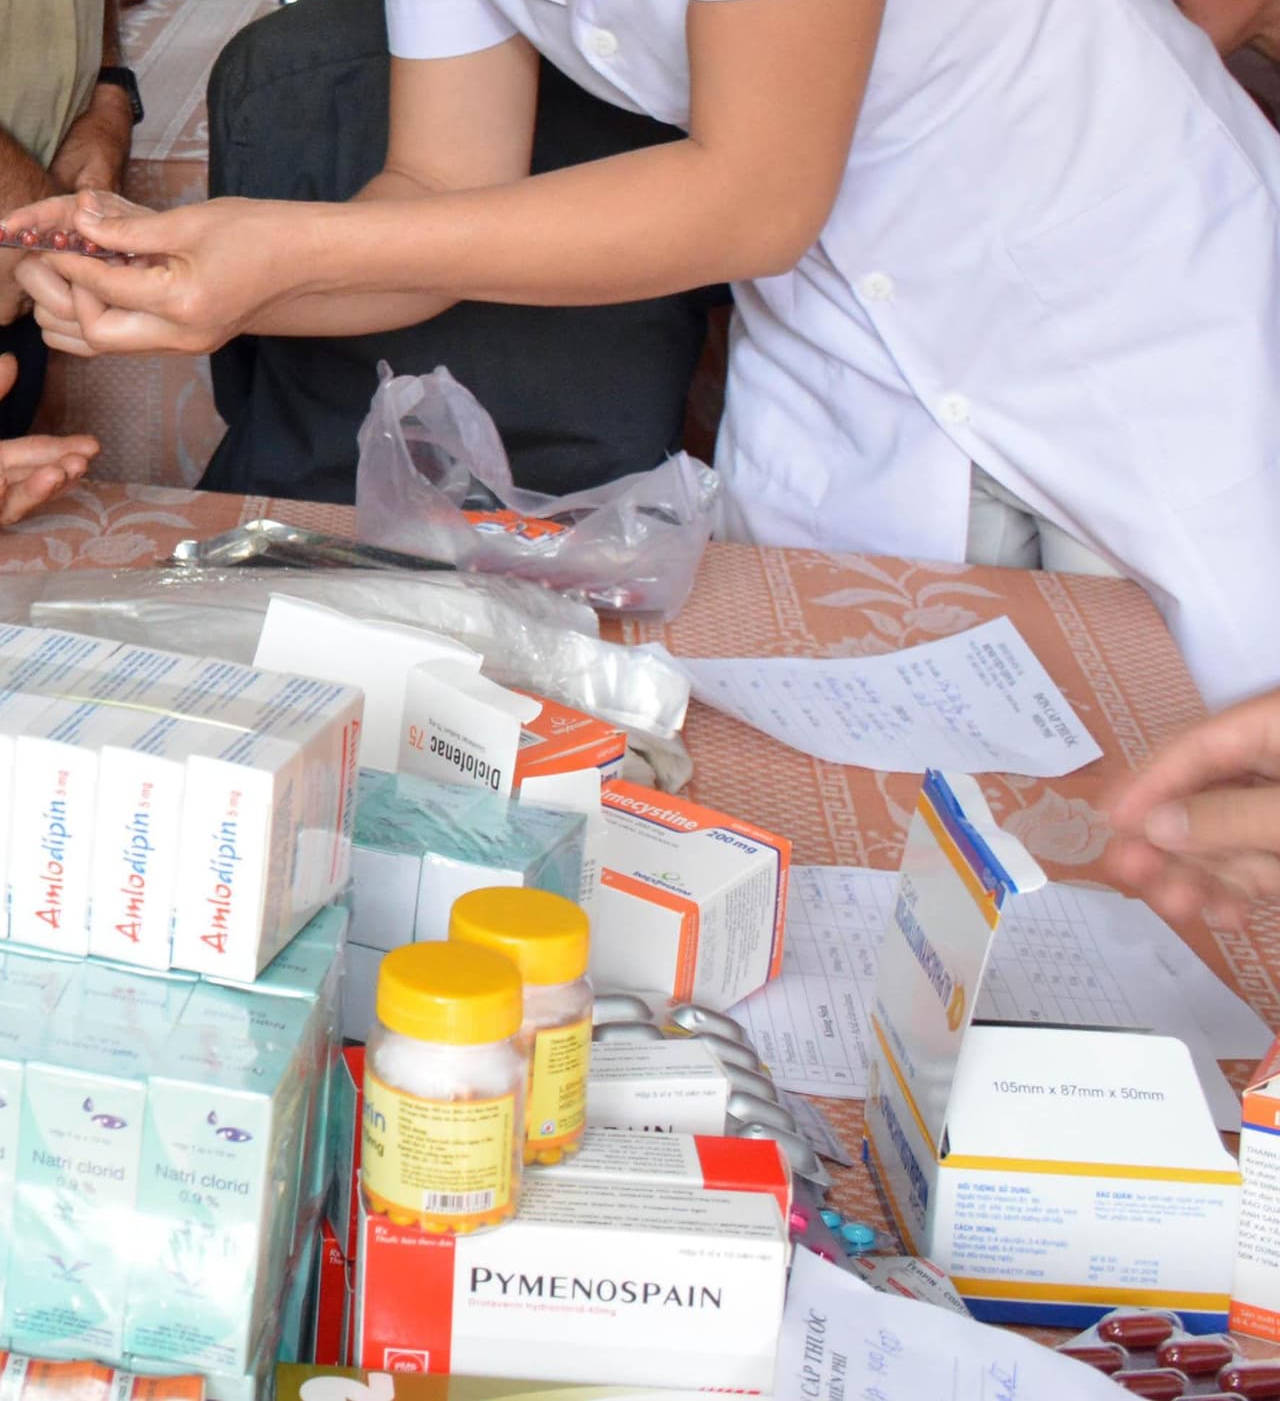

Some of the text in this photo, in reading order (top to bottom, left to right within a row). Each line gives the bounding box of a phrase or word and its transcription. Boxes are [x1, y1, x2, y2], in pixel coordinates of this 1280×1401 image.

[408, 724, 425, 750] 75
[429, 736, 501, 790] Diclofenac
[706, 829, 733, 845] 200
[734, 840, 758, 855] mg
[35, 799, 72, 929] Amlodipin
[115, 812, 156, 943] Amlodipin
[200, 821, 243, 954] Amlodipin
[993, 1080, 1166, 1102] 105mm x 87mm x 50mm
[31, 1148, 126, 1182] Natri clorid
[154, 1162, 251, 1196] Natri clorid
[470, 1265, 724, 1310] PYMENOSPAIN
